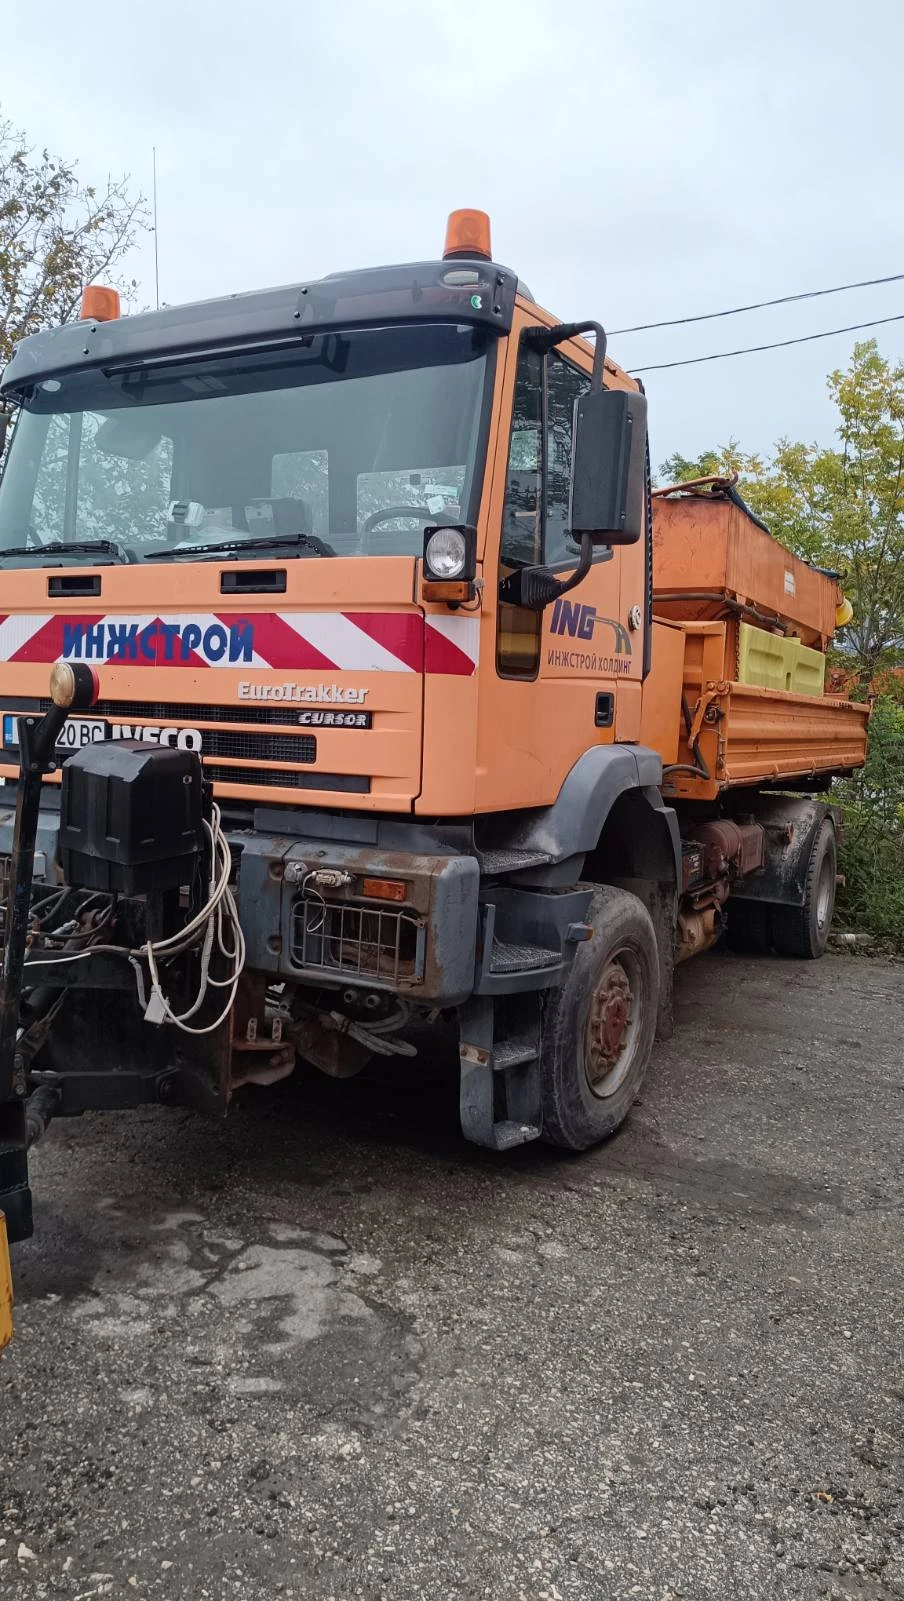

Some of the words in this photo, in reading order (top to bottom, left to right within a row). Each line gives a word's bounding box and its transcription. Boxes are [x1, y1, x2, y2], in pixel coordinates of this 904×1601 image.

[550, 598, 597, 640] ING
[63, 619, 255, 662] ИНЖСТРОЙ
[547, 649, 597, 670] ИНЖСТРОЙ
[599, 655, 632, 674] ХОЛДИНГ
[237, 681, 369, 704] EuroTrakker
[298, 712, 367, 726] CURSOR
